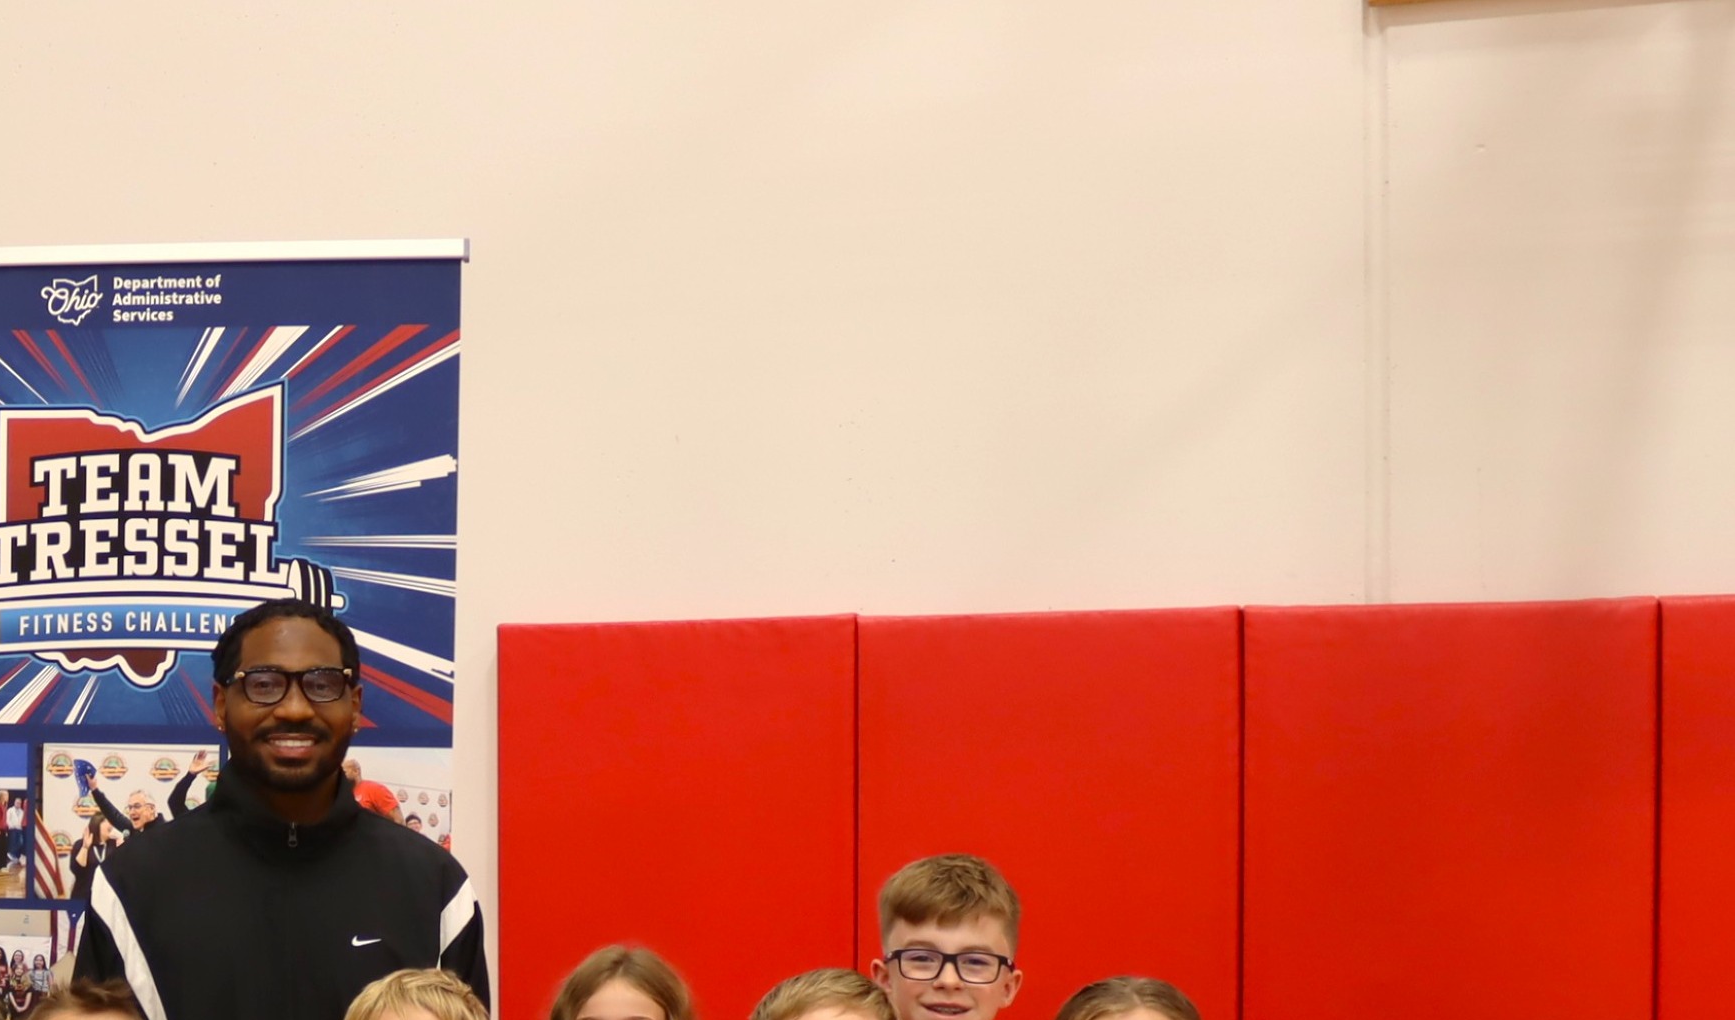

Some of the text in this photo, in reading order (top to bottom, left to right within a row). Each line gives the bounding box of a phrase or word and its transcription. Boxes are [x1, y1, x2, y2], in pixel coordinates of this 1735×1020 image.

[113, 274, 222, 291] Department of
[41, 286, 103, 315] Ohio
[112, 290, 222, 305] Administrative
[113, 308, 174, 322] Services
[33, 453, 236, 517] TEAM
[19, 610, 236, 636] FITNESS CHALLEN
